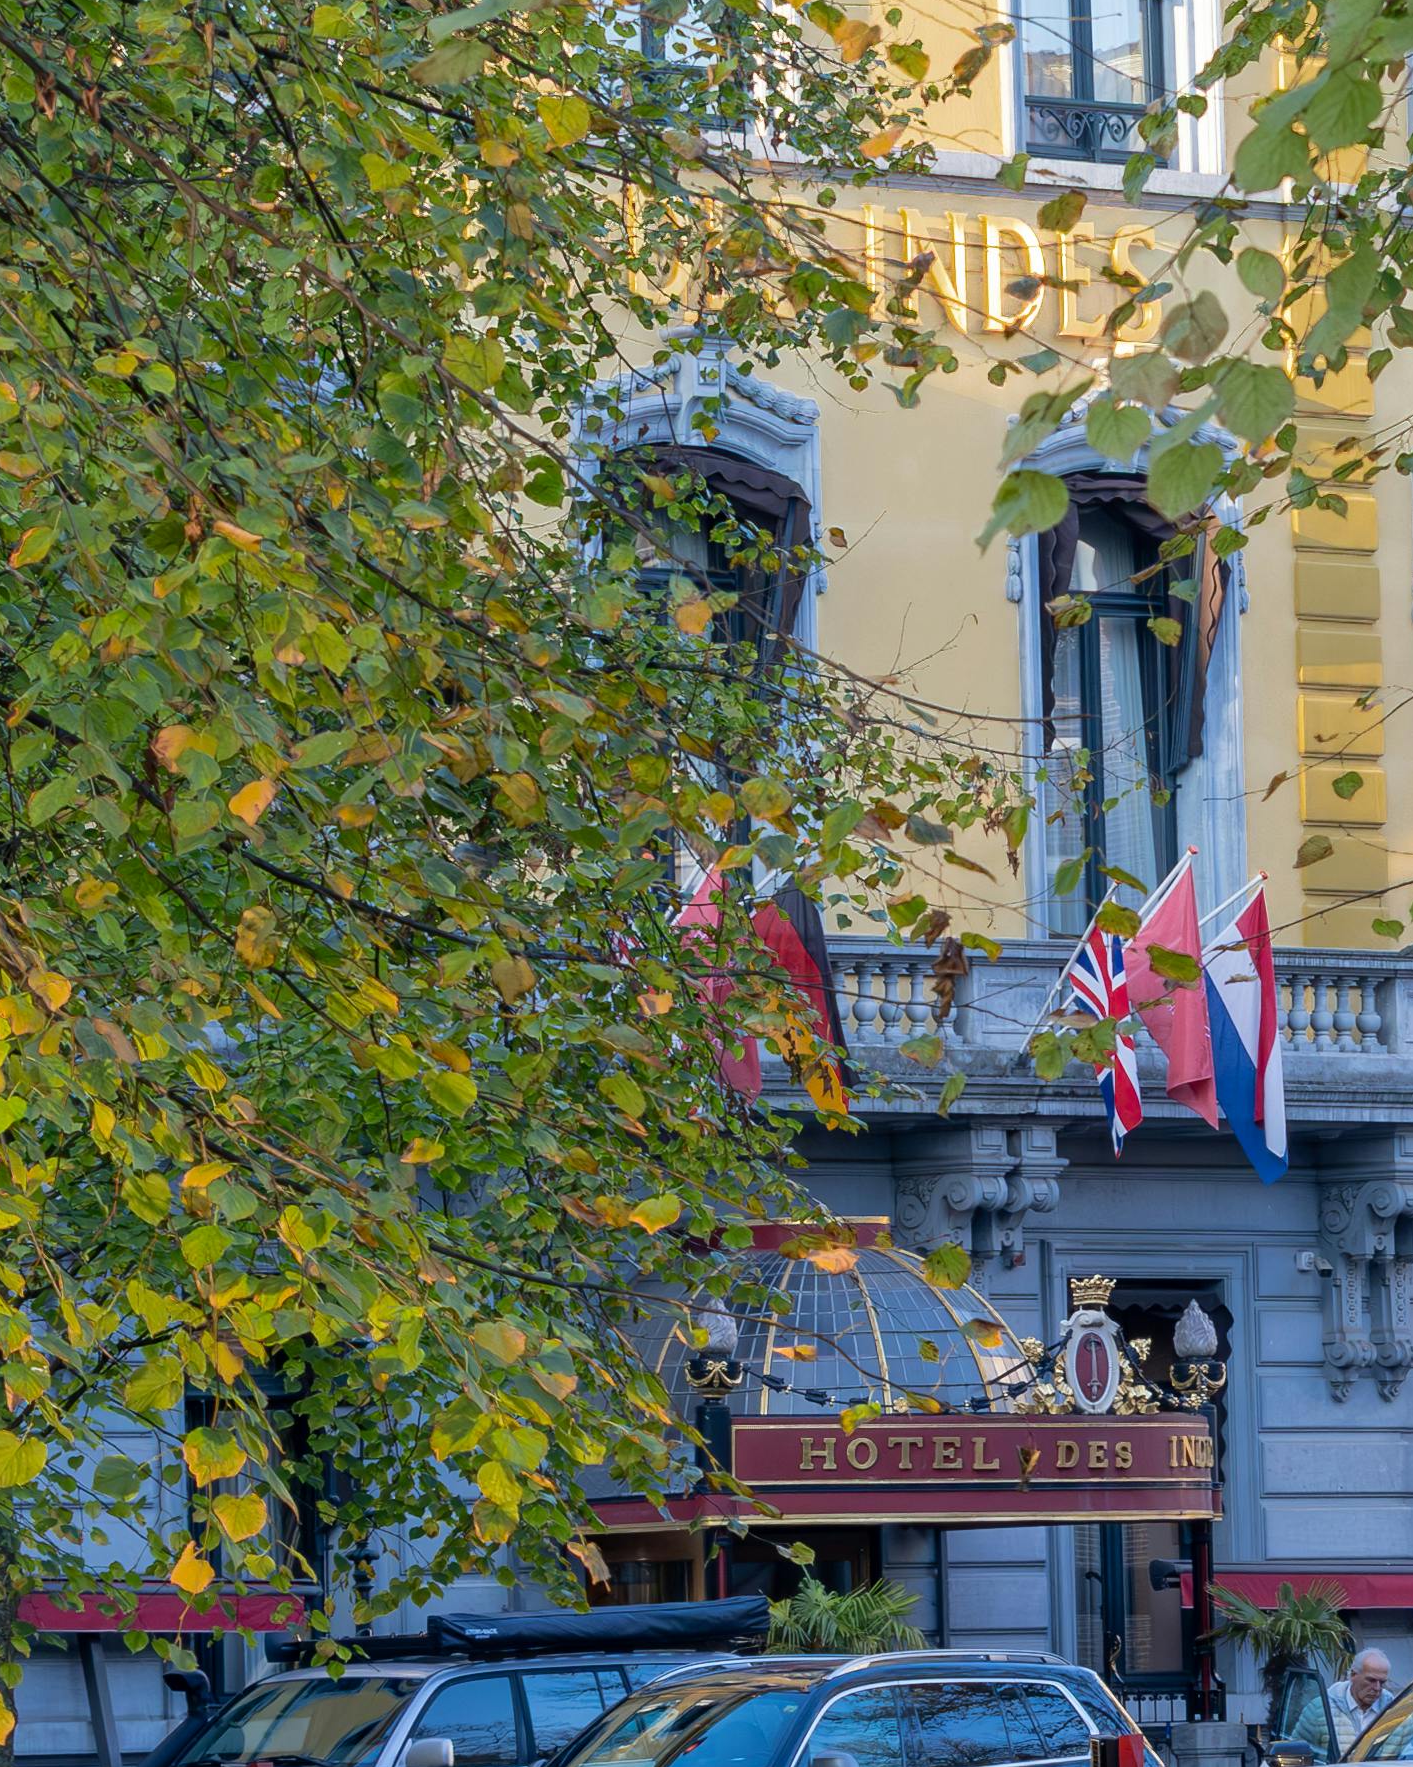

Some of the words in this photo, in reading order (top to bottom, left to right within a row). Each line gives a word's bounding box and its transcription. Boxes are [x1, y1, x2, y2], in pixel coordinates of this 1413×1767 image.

[862, 203, 1163, 342] INDES
[798, 1437, 1001, 1471] HOTEL
[1056, 1440, 1134, 1470] DES
[1168, 1435, 1215, 1469] INDE
